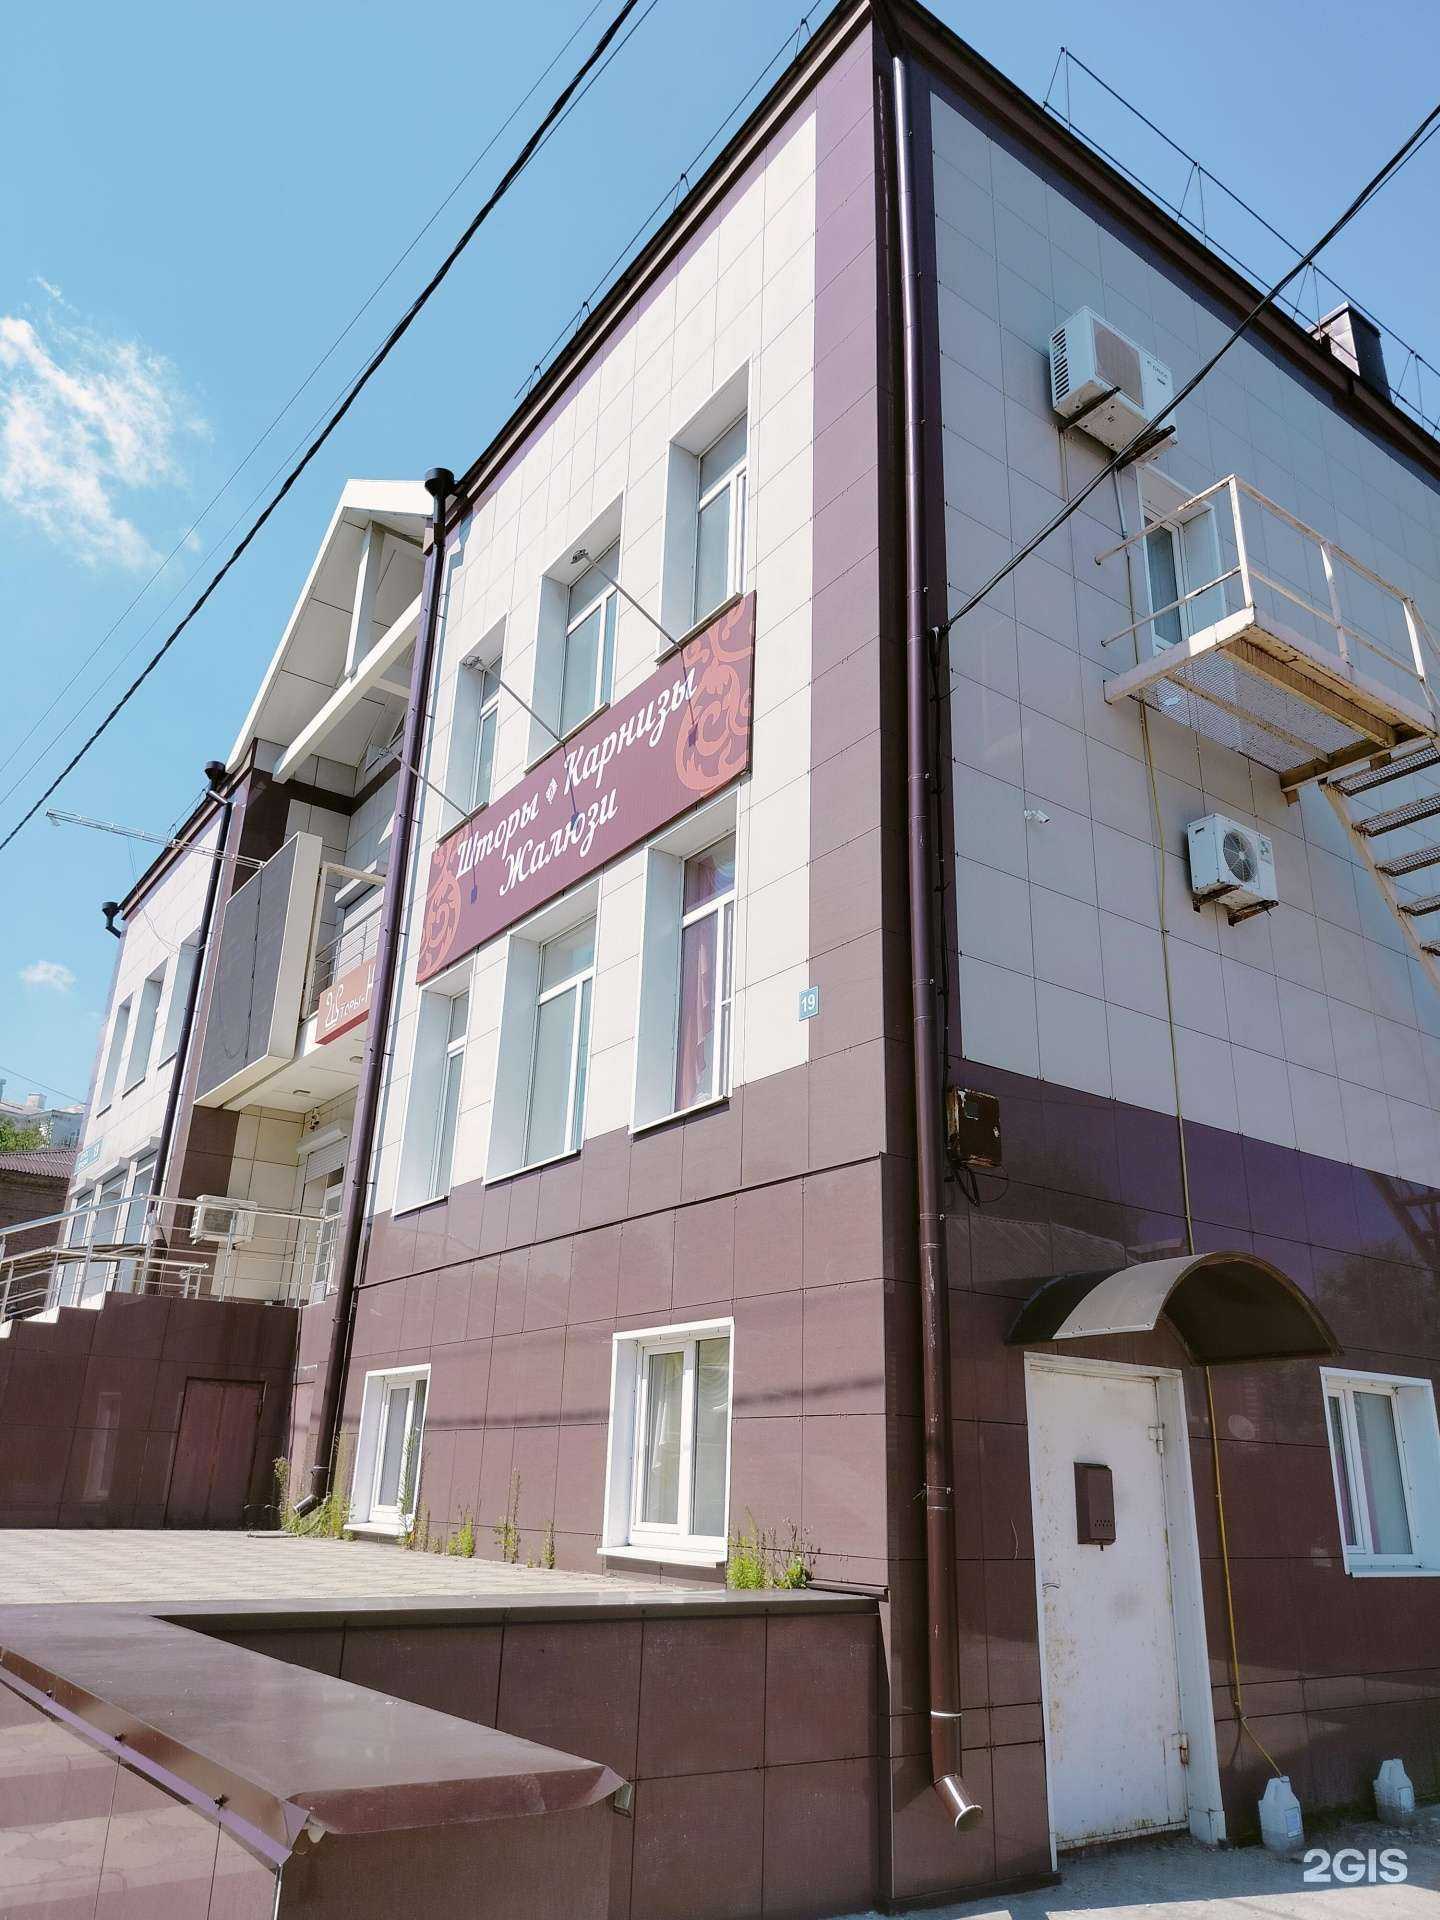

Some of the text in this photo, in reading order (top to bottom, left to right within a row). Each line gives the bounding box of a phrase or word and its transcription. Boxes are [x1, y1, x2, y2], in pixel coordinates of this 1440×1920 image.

[456, 666, 699, 880] Шторы Карнизы
[499, 788, 619, 897] Жалюзи
[801, 993, 816, 1013] 19
